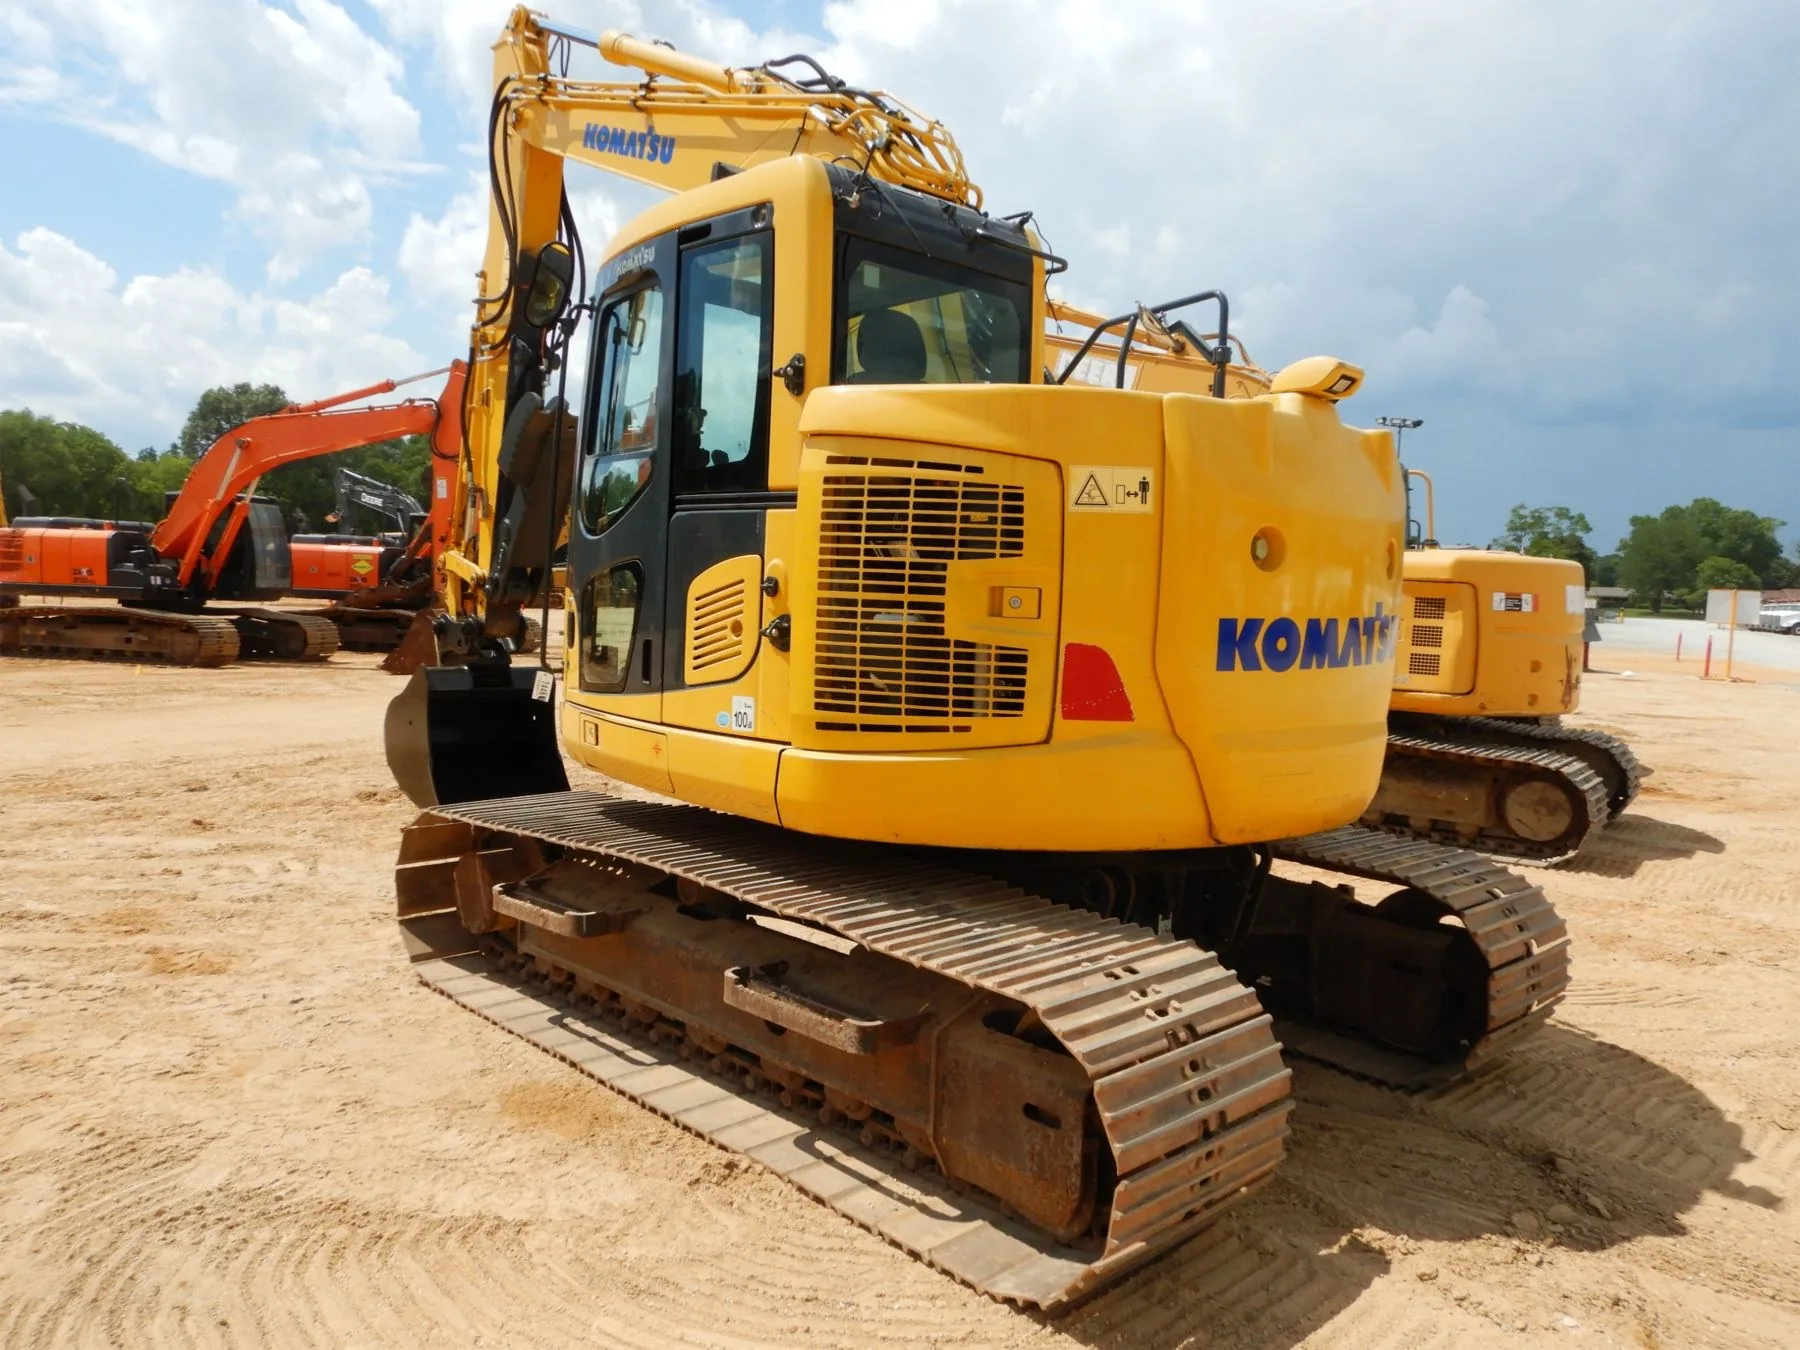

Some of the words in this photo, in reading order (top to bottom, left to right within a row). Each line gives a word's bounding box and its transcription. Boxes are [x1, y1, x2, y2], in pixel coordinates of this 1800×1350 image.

[583, 122, 676, 164] KOMATSU
[361, 492, 383, 507] DEERE
[733, 711, 748, 728] 100
